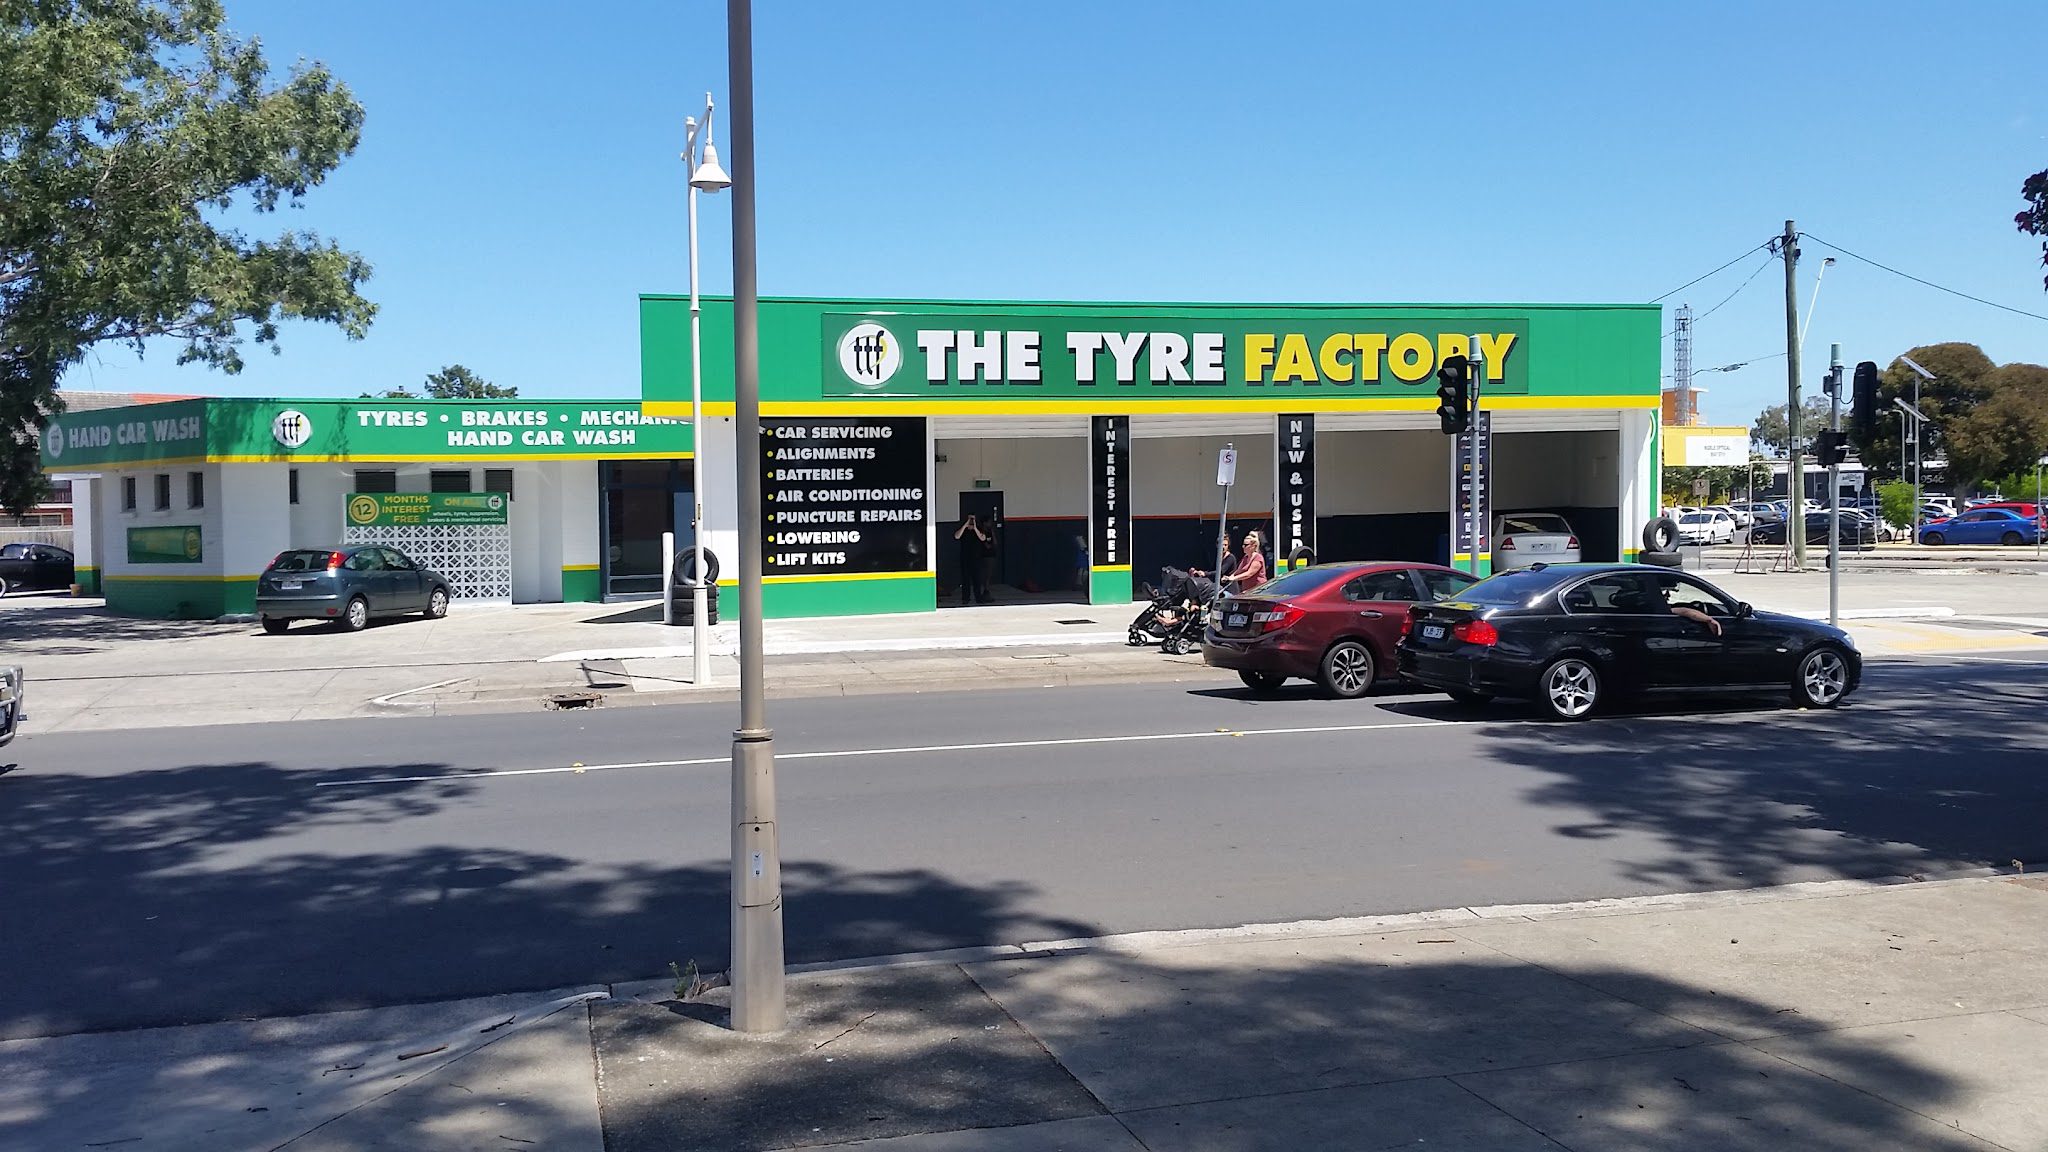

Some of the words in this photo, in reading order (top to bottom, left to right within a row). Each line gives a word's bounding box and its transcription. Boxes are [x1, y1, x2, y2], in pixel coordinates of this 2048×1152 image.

[917, 330, 1041, 383] THE
[1067, 332, 1226, 384] TYRE
[357, 410, 428, 427] TYRES
[461, 410, 548, 427] BRAKES
[69, 423, 110, 449] HAND
[116, 422, 147, 445] CAR
[152, 416, 200, 442] WASH
[447, 429, 513, 446] HAND
[521, 429, 566, 446] CAR
[571, 428, 636, 445] WASH
[775, 426, 807, 438] CAR
[811, 425, 893, 439] SERVICING
[1288, 420, 1305, 464] NEW
[775, 447, 876, 460] ALIGNMENTS
[1105, 418, 1117, 511] INTEREST
[776, 468, 854, 481] BATTERIES
[1290, 472, 1303, 485] &
[384, 495, 428, 504] MONTHS
[776, 490, 804, 502] AIR
[808, 488, 923, 502] CONDITIONING
[355, 503, 371, 516] 12
[382, 505, 431, 513] INTEREST
[776, 510, 856, 524] PUNCTURE
[860, 509, 923, 523] REPAIRS
[393, 515, 420, 523] FREE
[776, 530, 861, 545] LOWERING
[1106, 516, 1117, 563] FREE
[776, 552, 808, 566] LIFT
[811, 551, 846, 565] KITS
